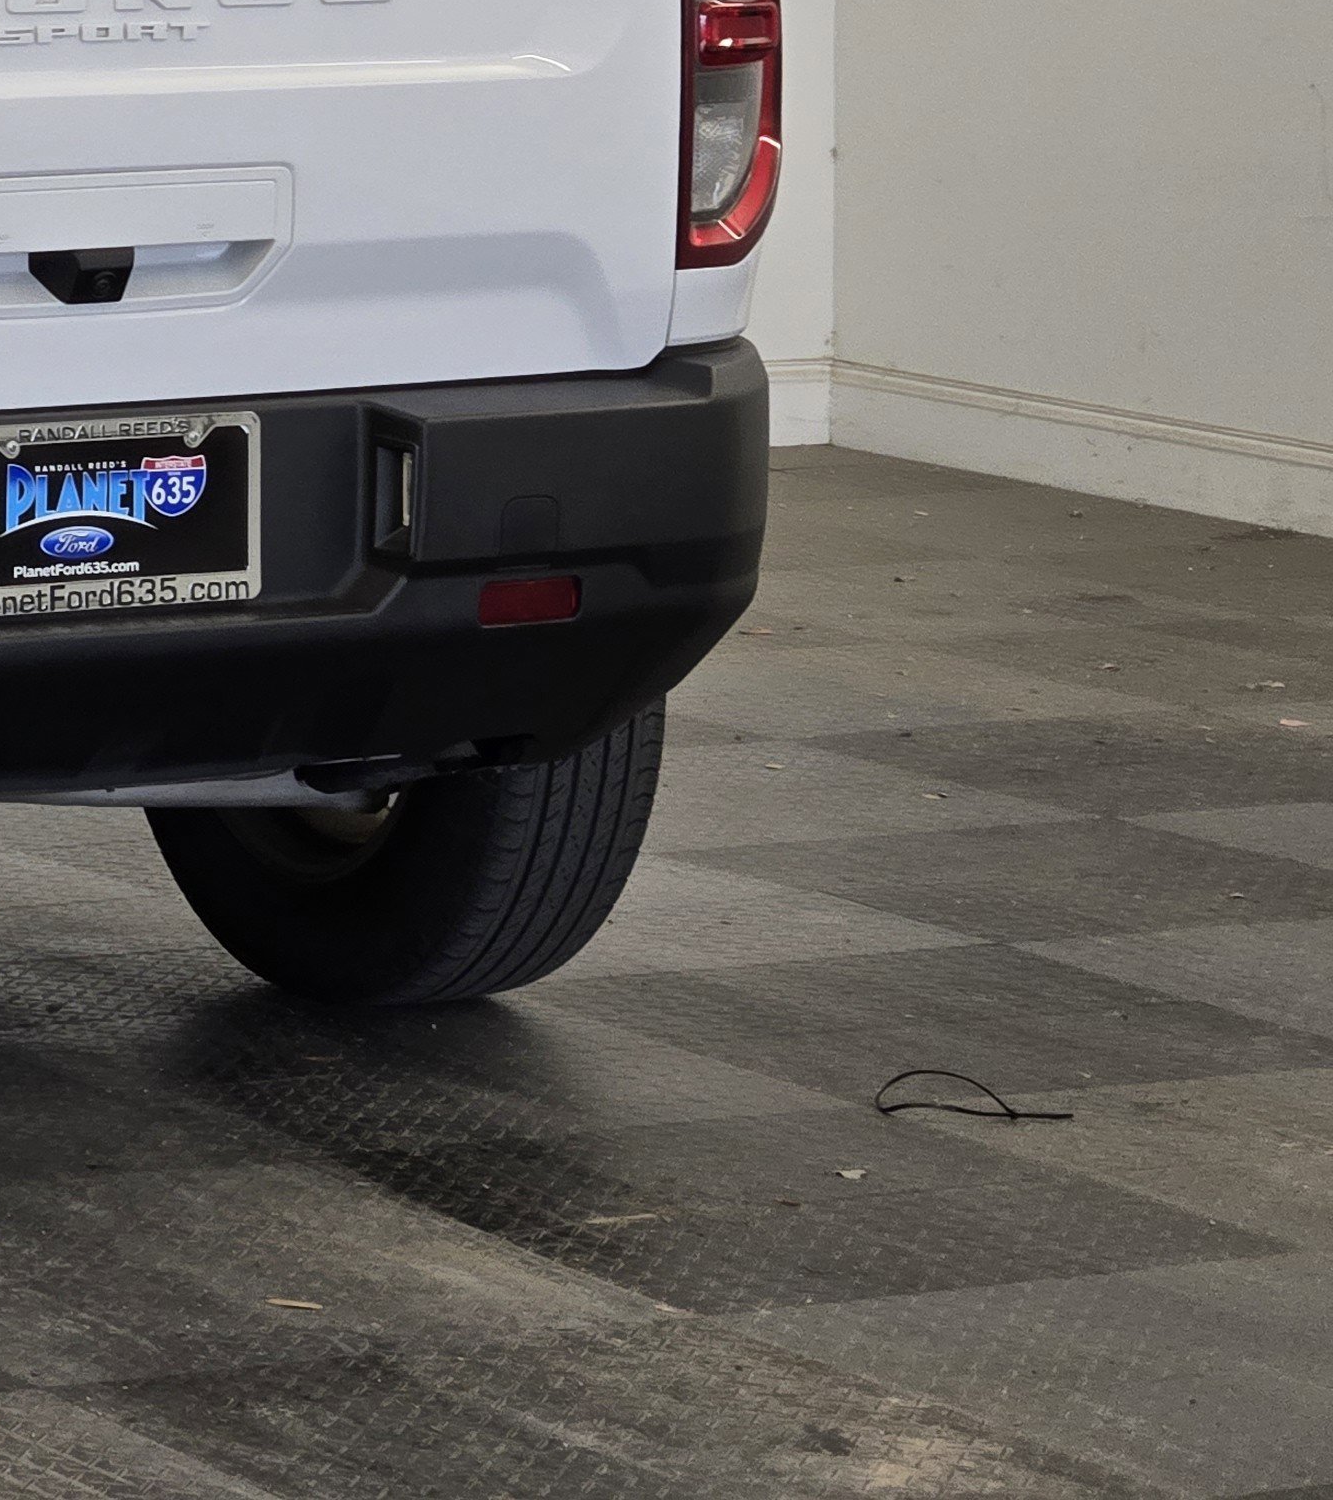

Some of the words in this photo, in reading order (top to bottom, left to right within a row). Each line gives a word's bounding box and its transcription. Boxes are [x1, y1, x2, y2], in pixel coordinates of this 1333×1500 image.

[18, 424, 112, 442] RANDALL
[118, 417, 191, 435] REED'S
[5, 463, 150, 533] PLANET
[151, 476, 195, 505] 635
[54, 530, 100, 553] Ford
[13, 561, 140, 578] PlanetFord635.com
